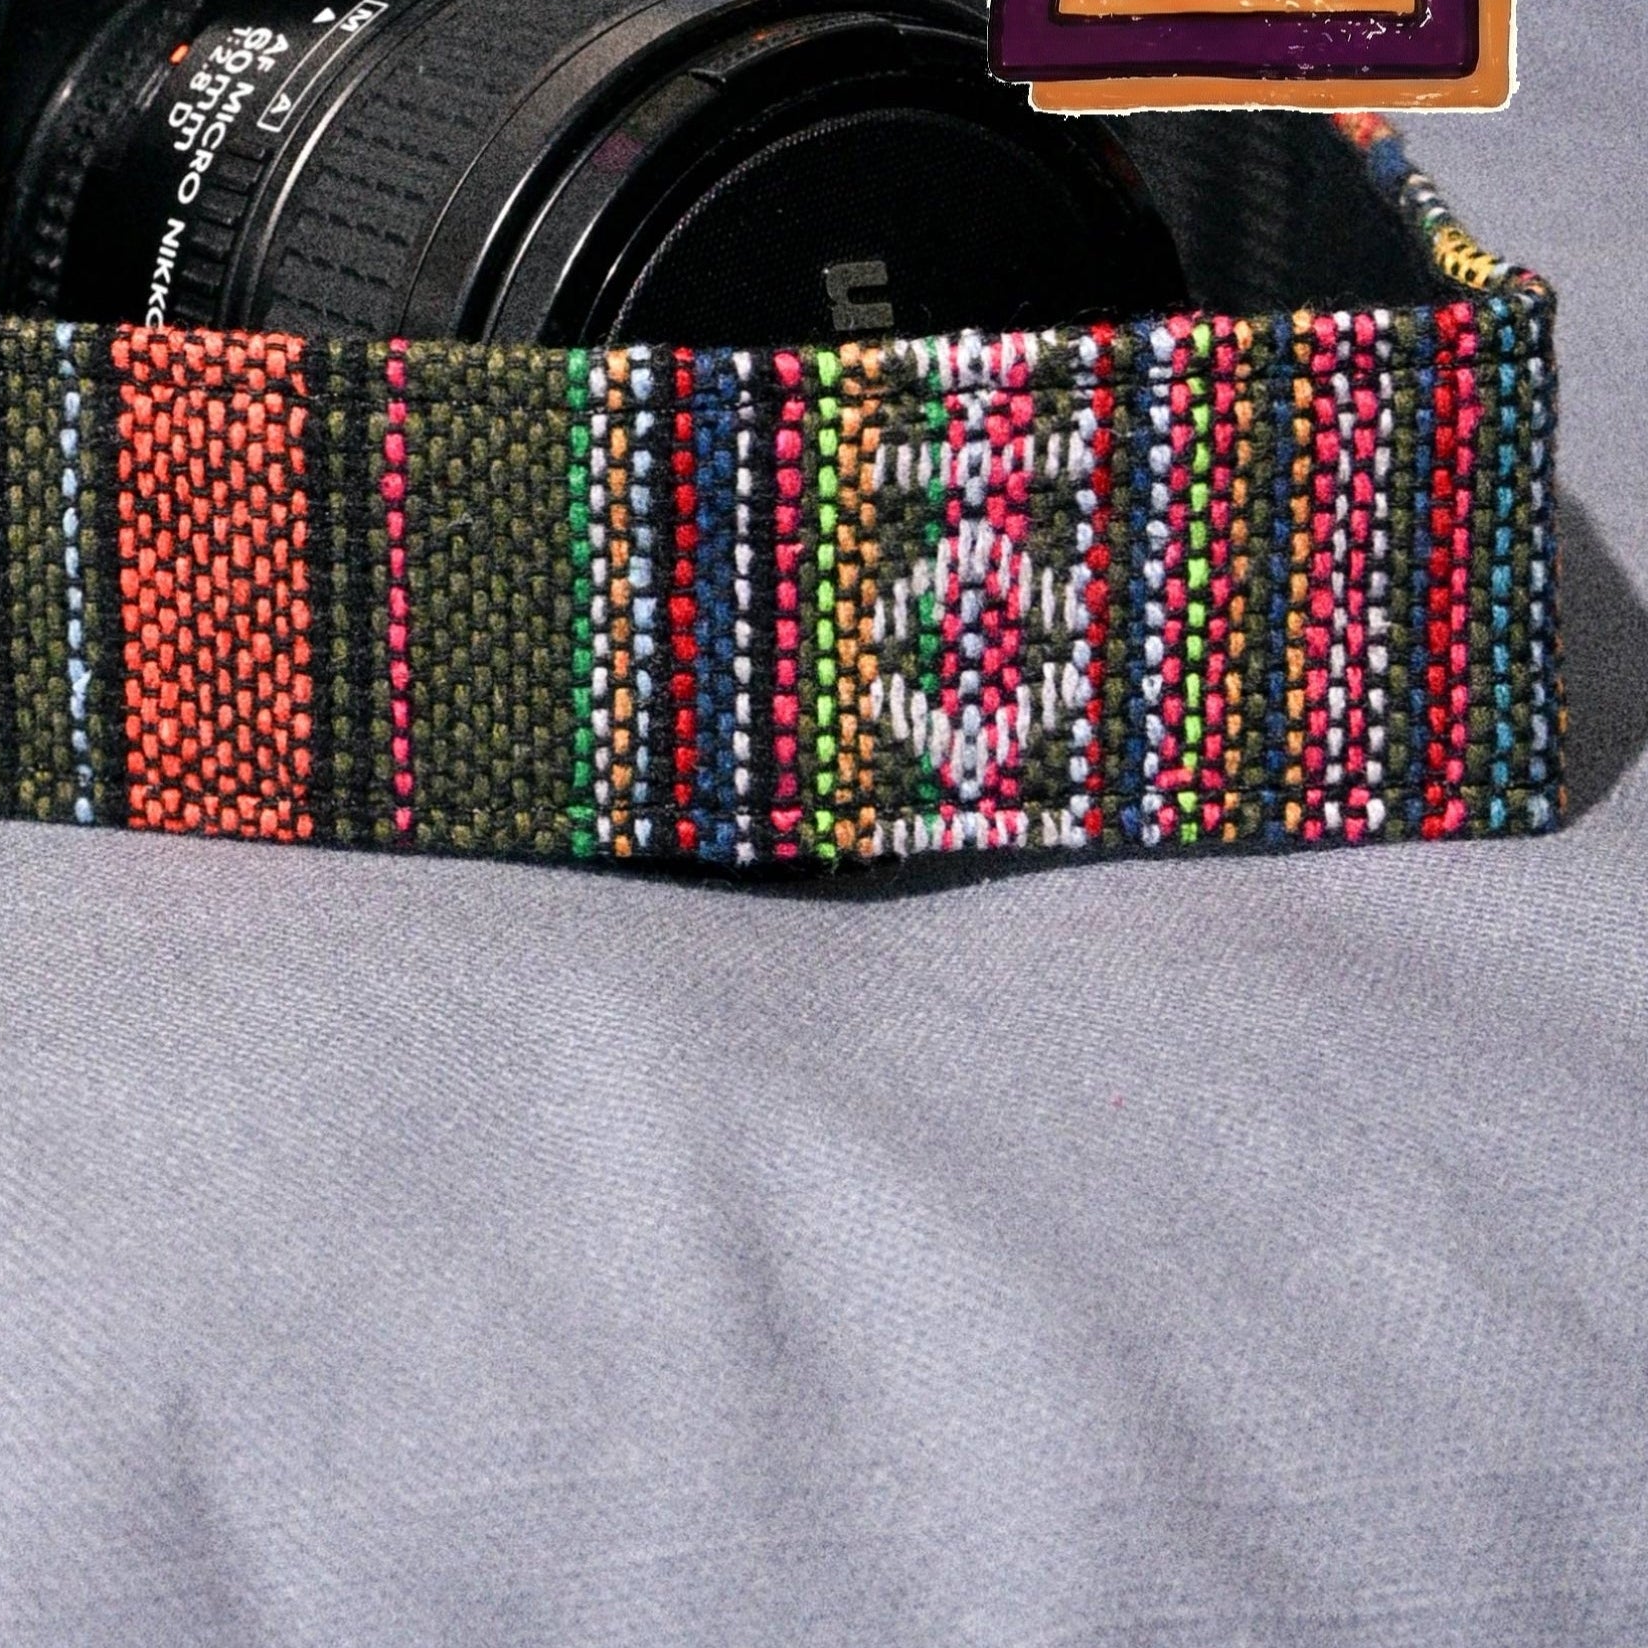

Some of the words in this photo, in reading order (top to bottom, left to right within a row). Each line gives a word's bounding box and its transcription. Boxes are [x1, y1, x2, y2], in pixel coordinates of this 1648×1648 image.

[340, 7, 374, 33] M
[260, 32, 290, 73] AF
[168, 100, 194, 128] D
[269, 92, 293, 115] A
[177, 81, 255, 205] MICRO
